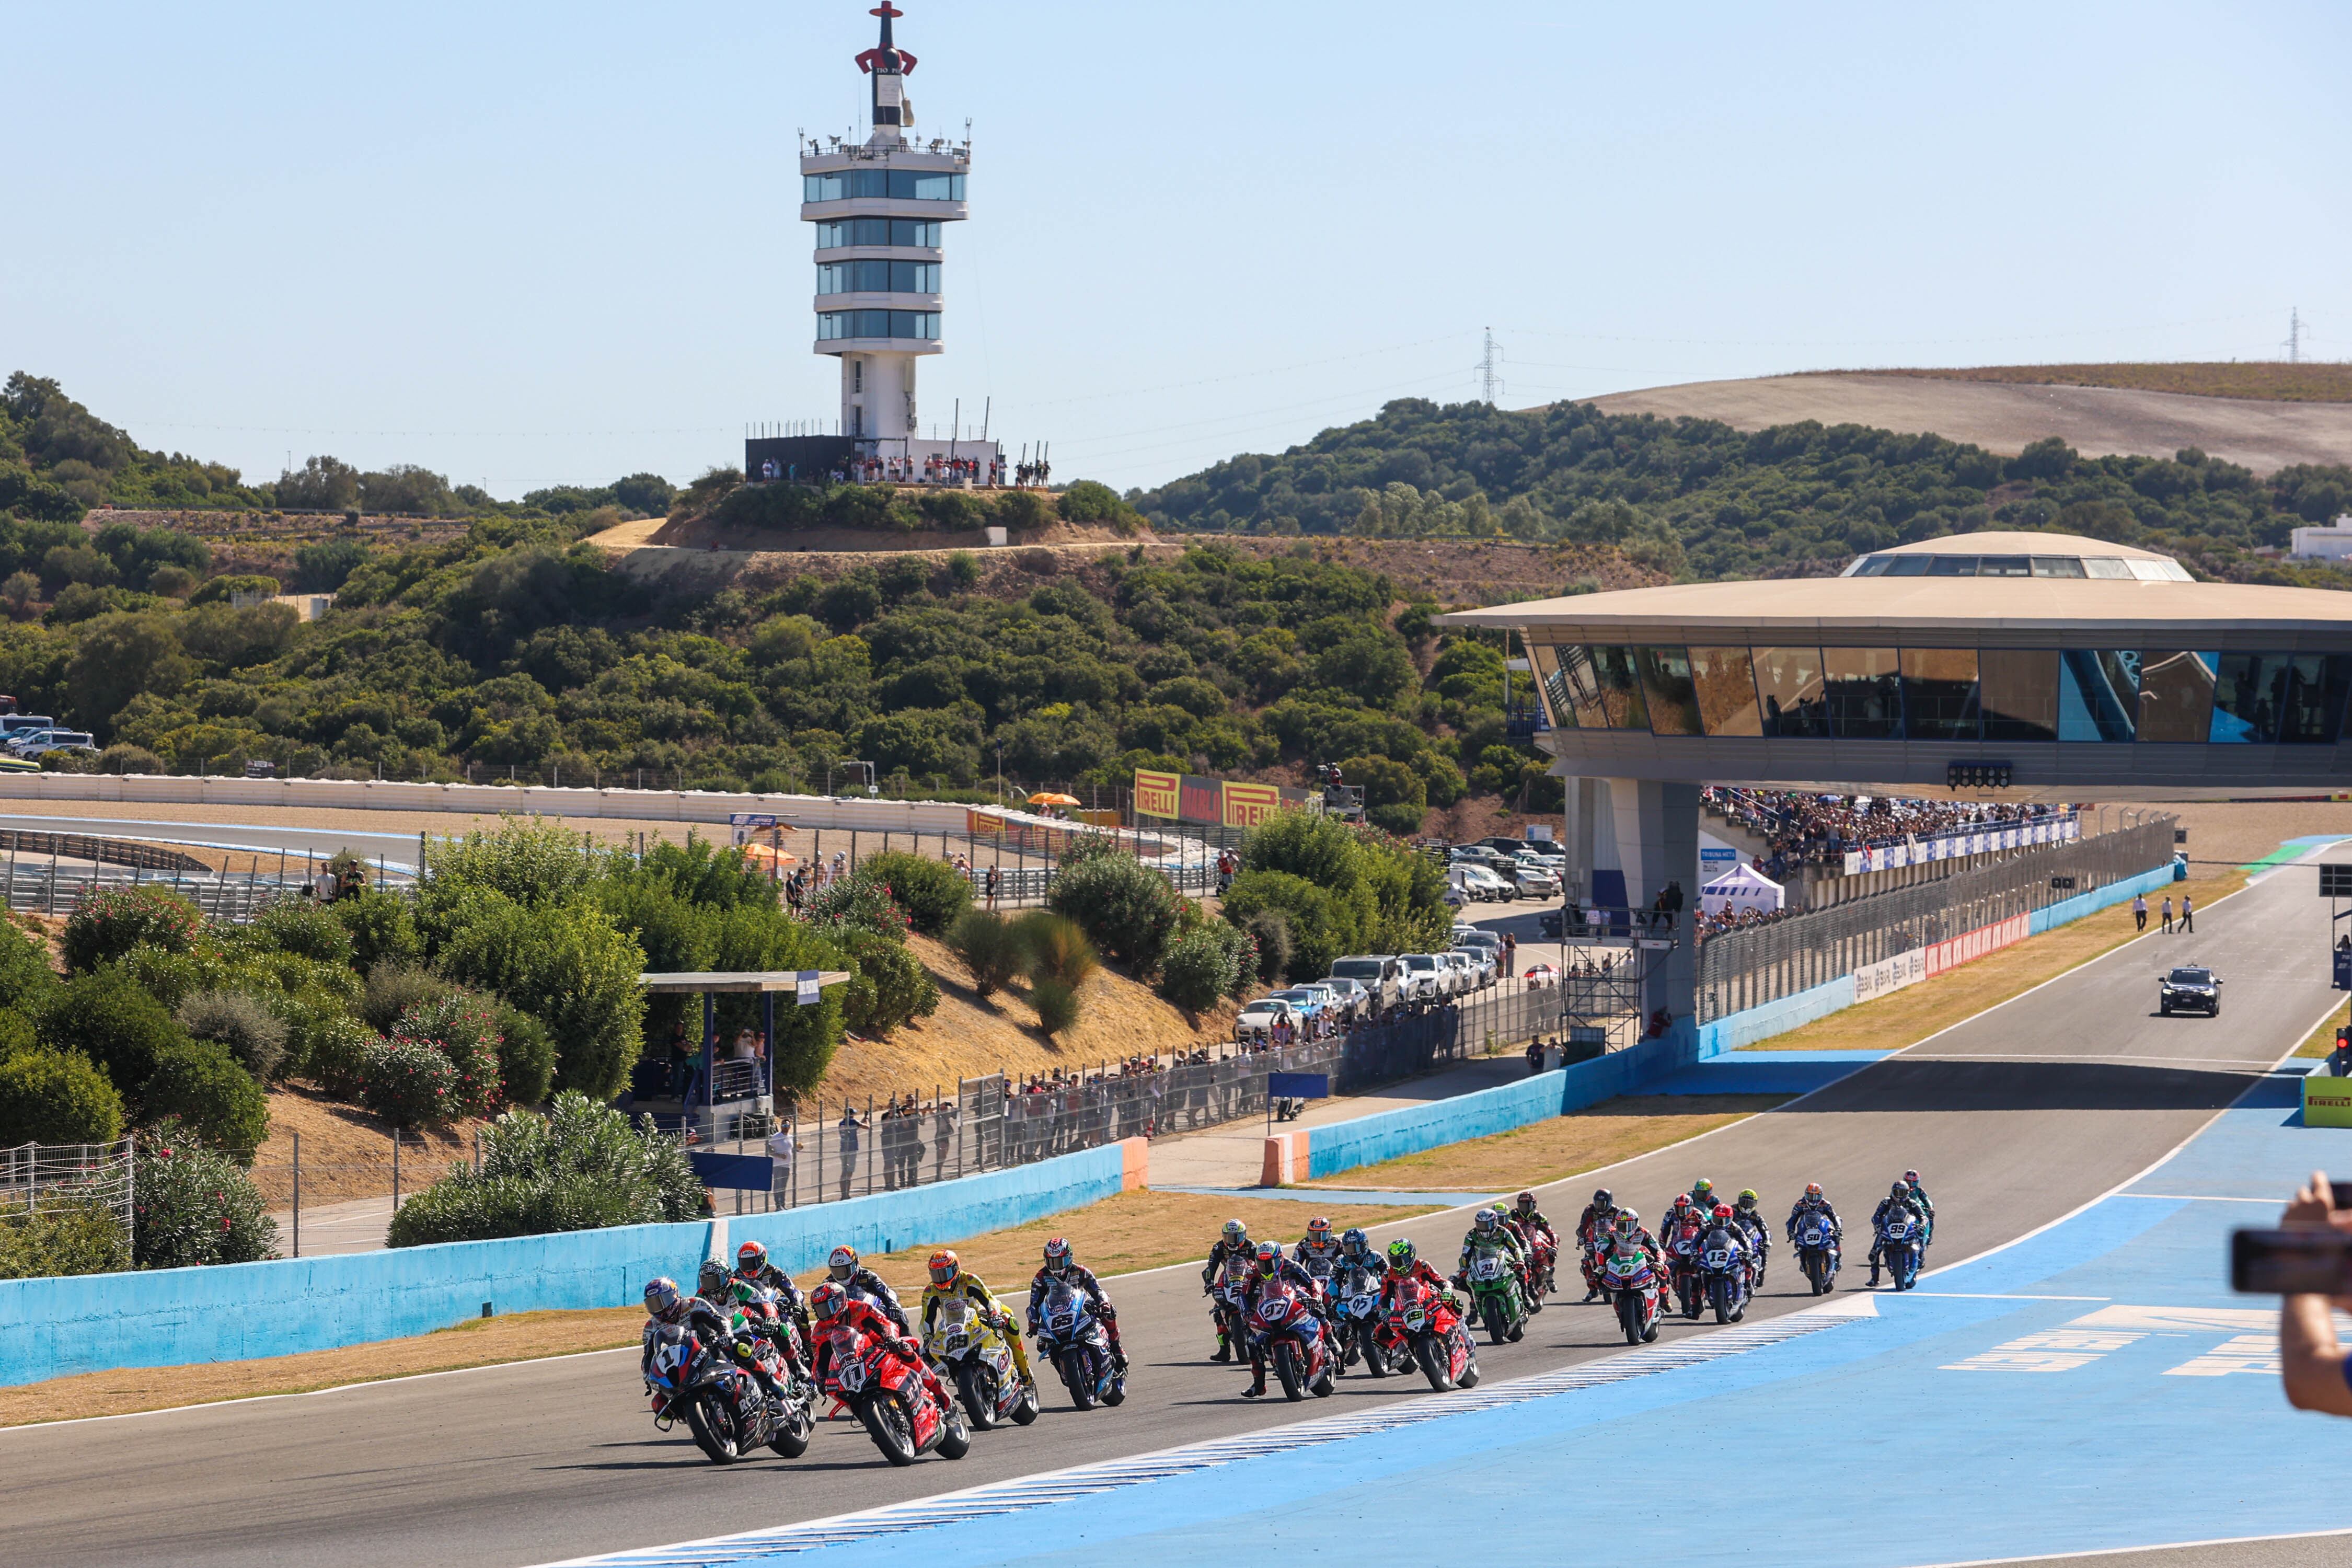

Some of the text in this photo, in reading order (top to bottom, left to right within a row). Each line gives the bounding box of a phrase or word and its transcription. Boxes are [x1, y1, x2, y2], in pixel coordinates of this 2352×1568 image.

[1137, 773, 1176, 814] PIRELLI
[1181, 785, 1221, 823] DIABLO
[2308, 1096, 2350, 1106] PIRELLI
[1890, 1225, 1905, 1234] 99
[1710, 1252, 1728, 1262] 12
[1265, 1302, 1286, 1318] 97
[1353, 1297, 1370, 1313] 95
[1051, 1313, 1073, 1330] 65
[1407, 1311, 1423, 1324] 19
[947, 1334, 969, 1354] 29
[662, 1349, 674, 1368] 1
[842, 1365, 862, 1390] 11
